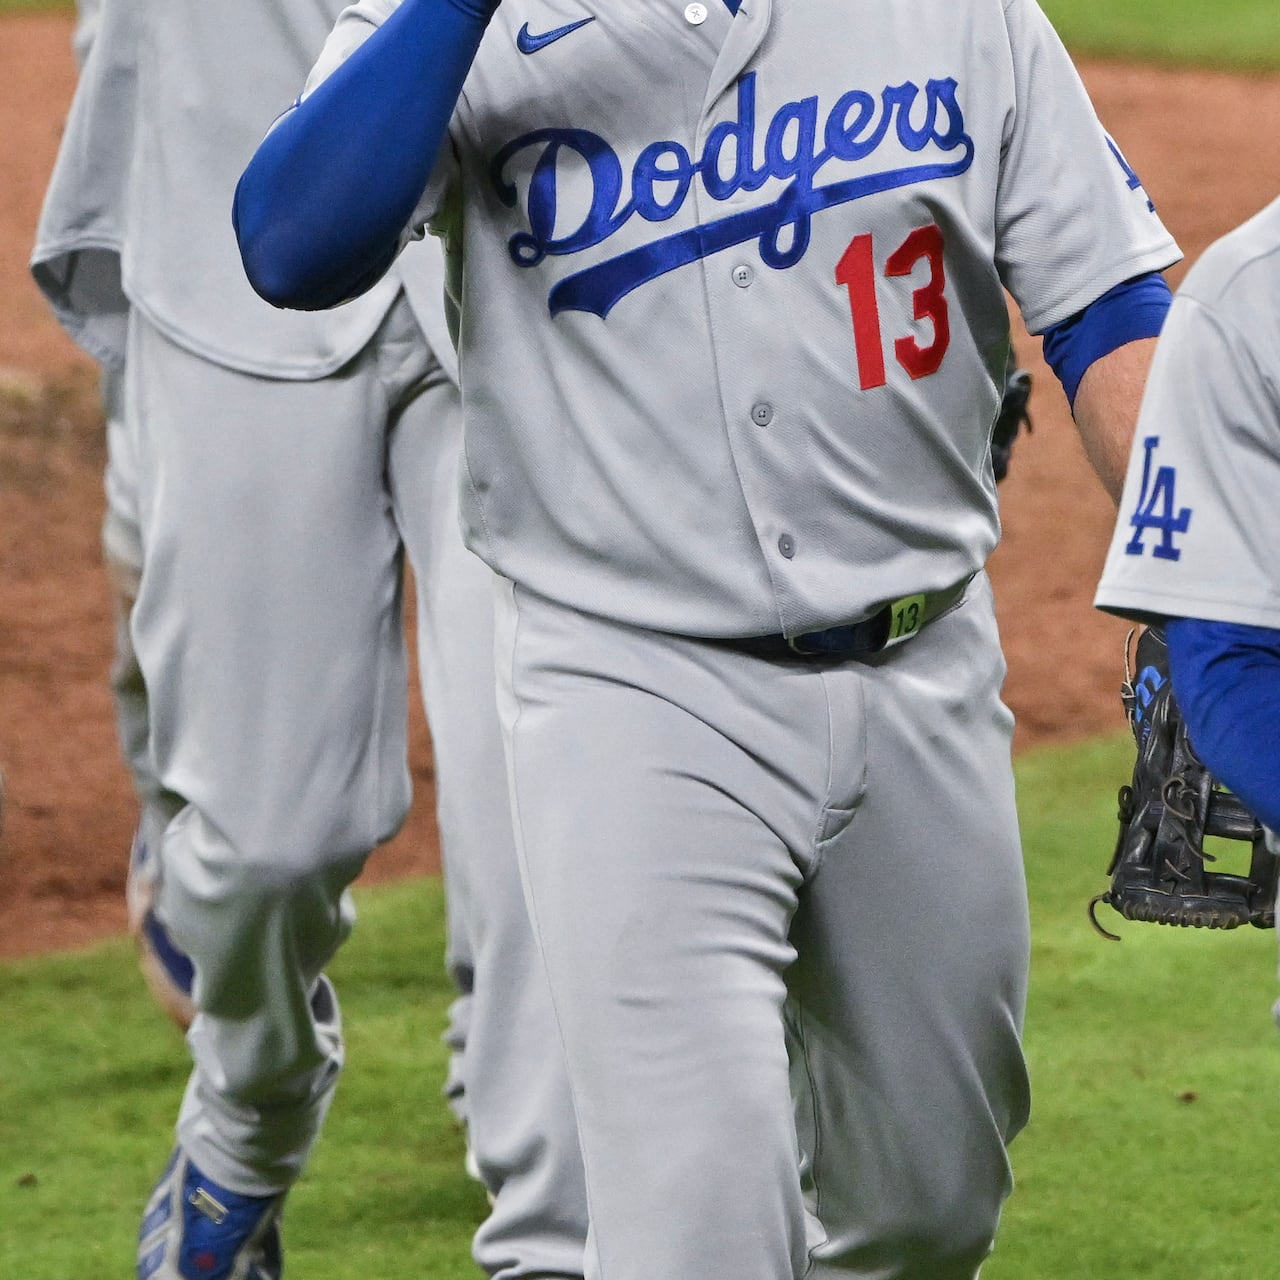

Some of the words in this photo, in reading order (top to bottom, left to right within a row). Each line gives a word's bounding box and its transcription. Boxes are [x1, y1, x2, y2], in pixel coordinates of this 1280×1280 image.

[491, 70, 973, 269] Dodgers
[835, 224, 950, 390] 13
[1125, 435, 1192, 562] LA
[894, 602, 920, 638] 13
